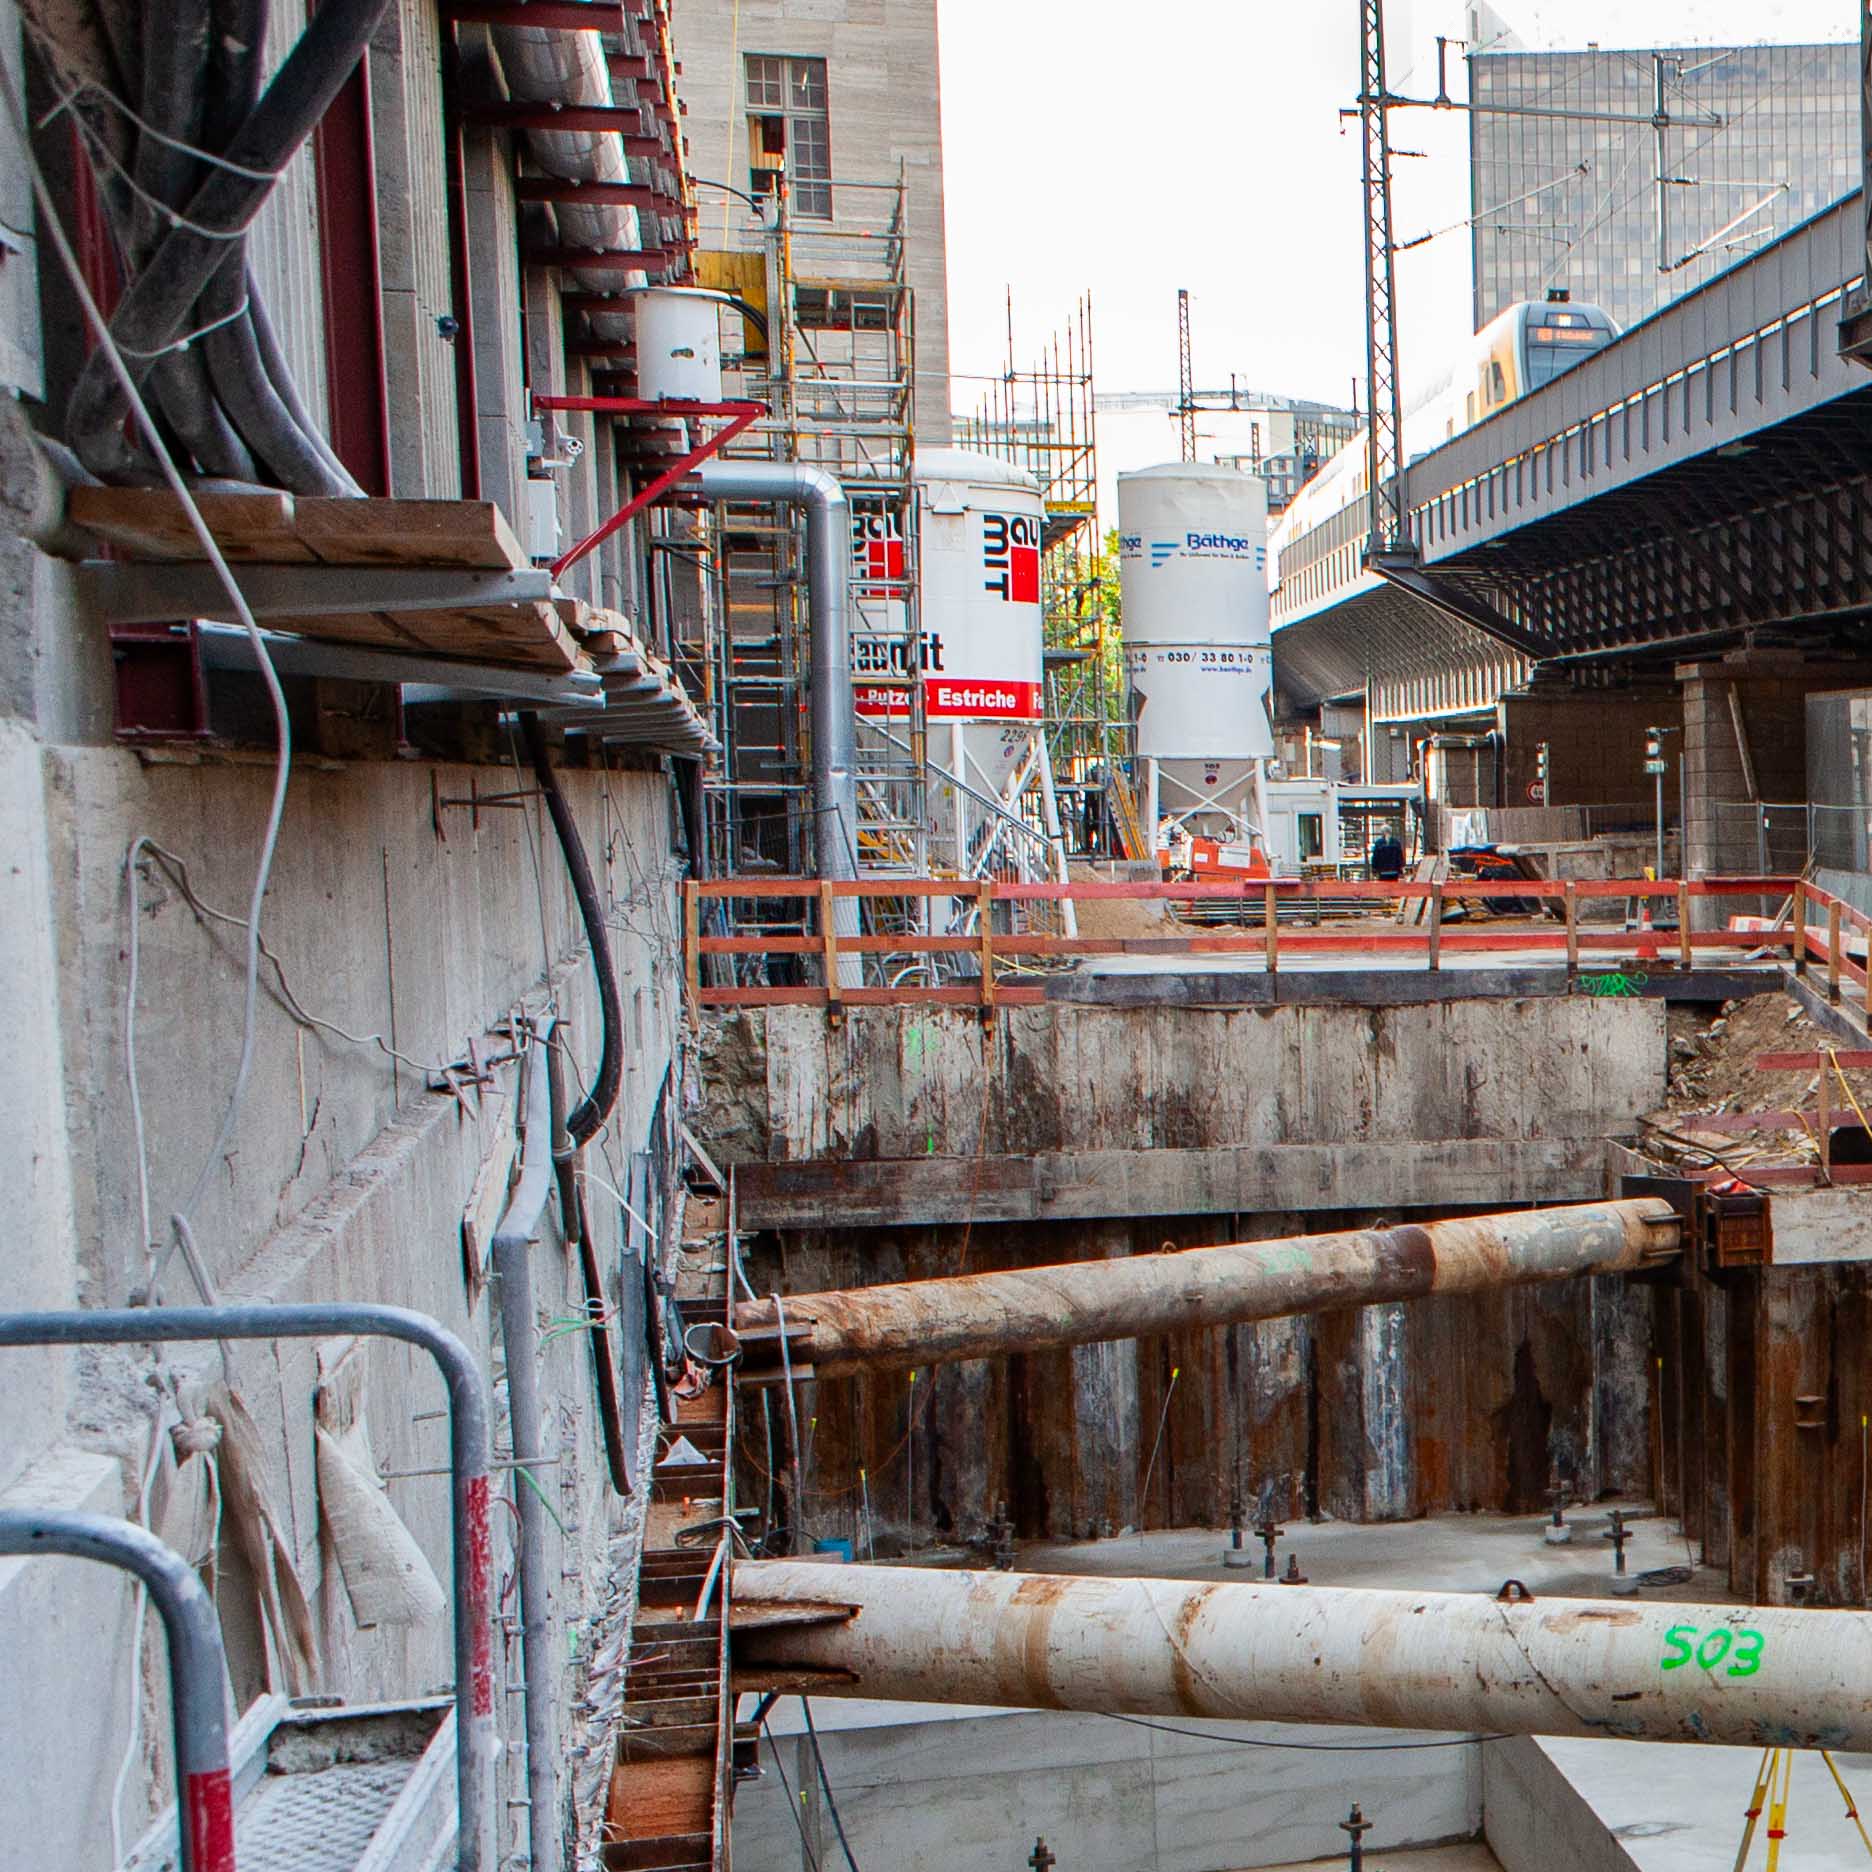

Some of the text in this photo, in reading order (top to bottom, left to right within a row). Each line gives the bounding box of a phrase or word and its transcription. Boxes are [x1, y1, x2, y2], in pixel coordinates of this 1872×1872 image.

[1187, 533, 1249, 551] Bäthge
[1201, 652, 1217, 663] 33
[1221, 653, 1235, 663] 80
[1238, 653, 1254, 664] 1-0
[938, 687, 1017, 710] Estriche
[1661, 1625, 1765, 1677] S03
